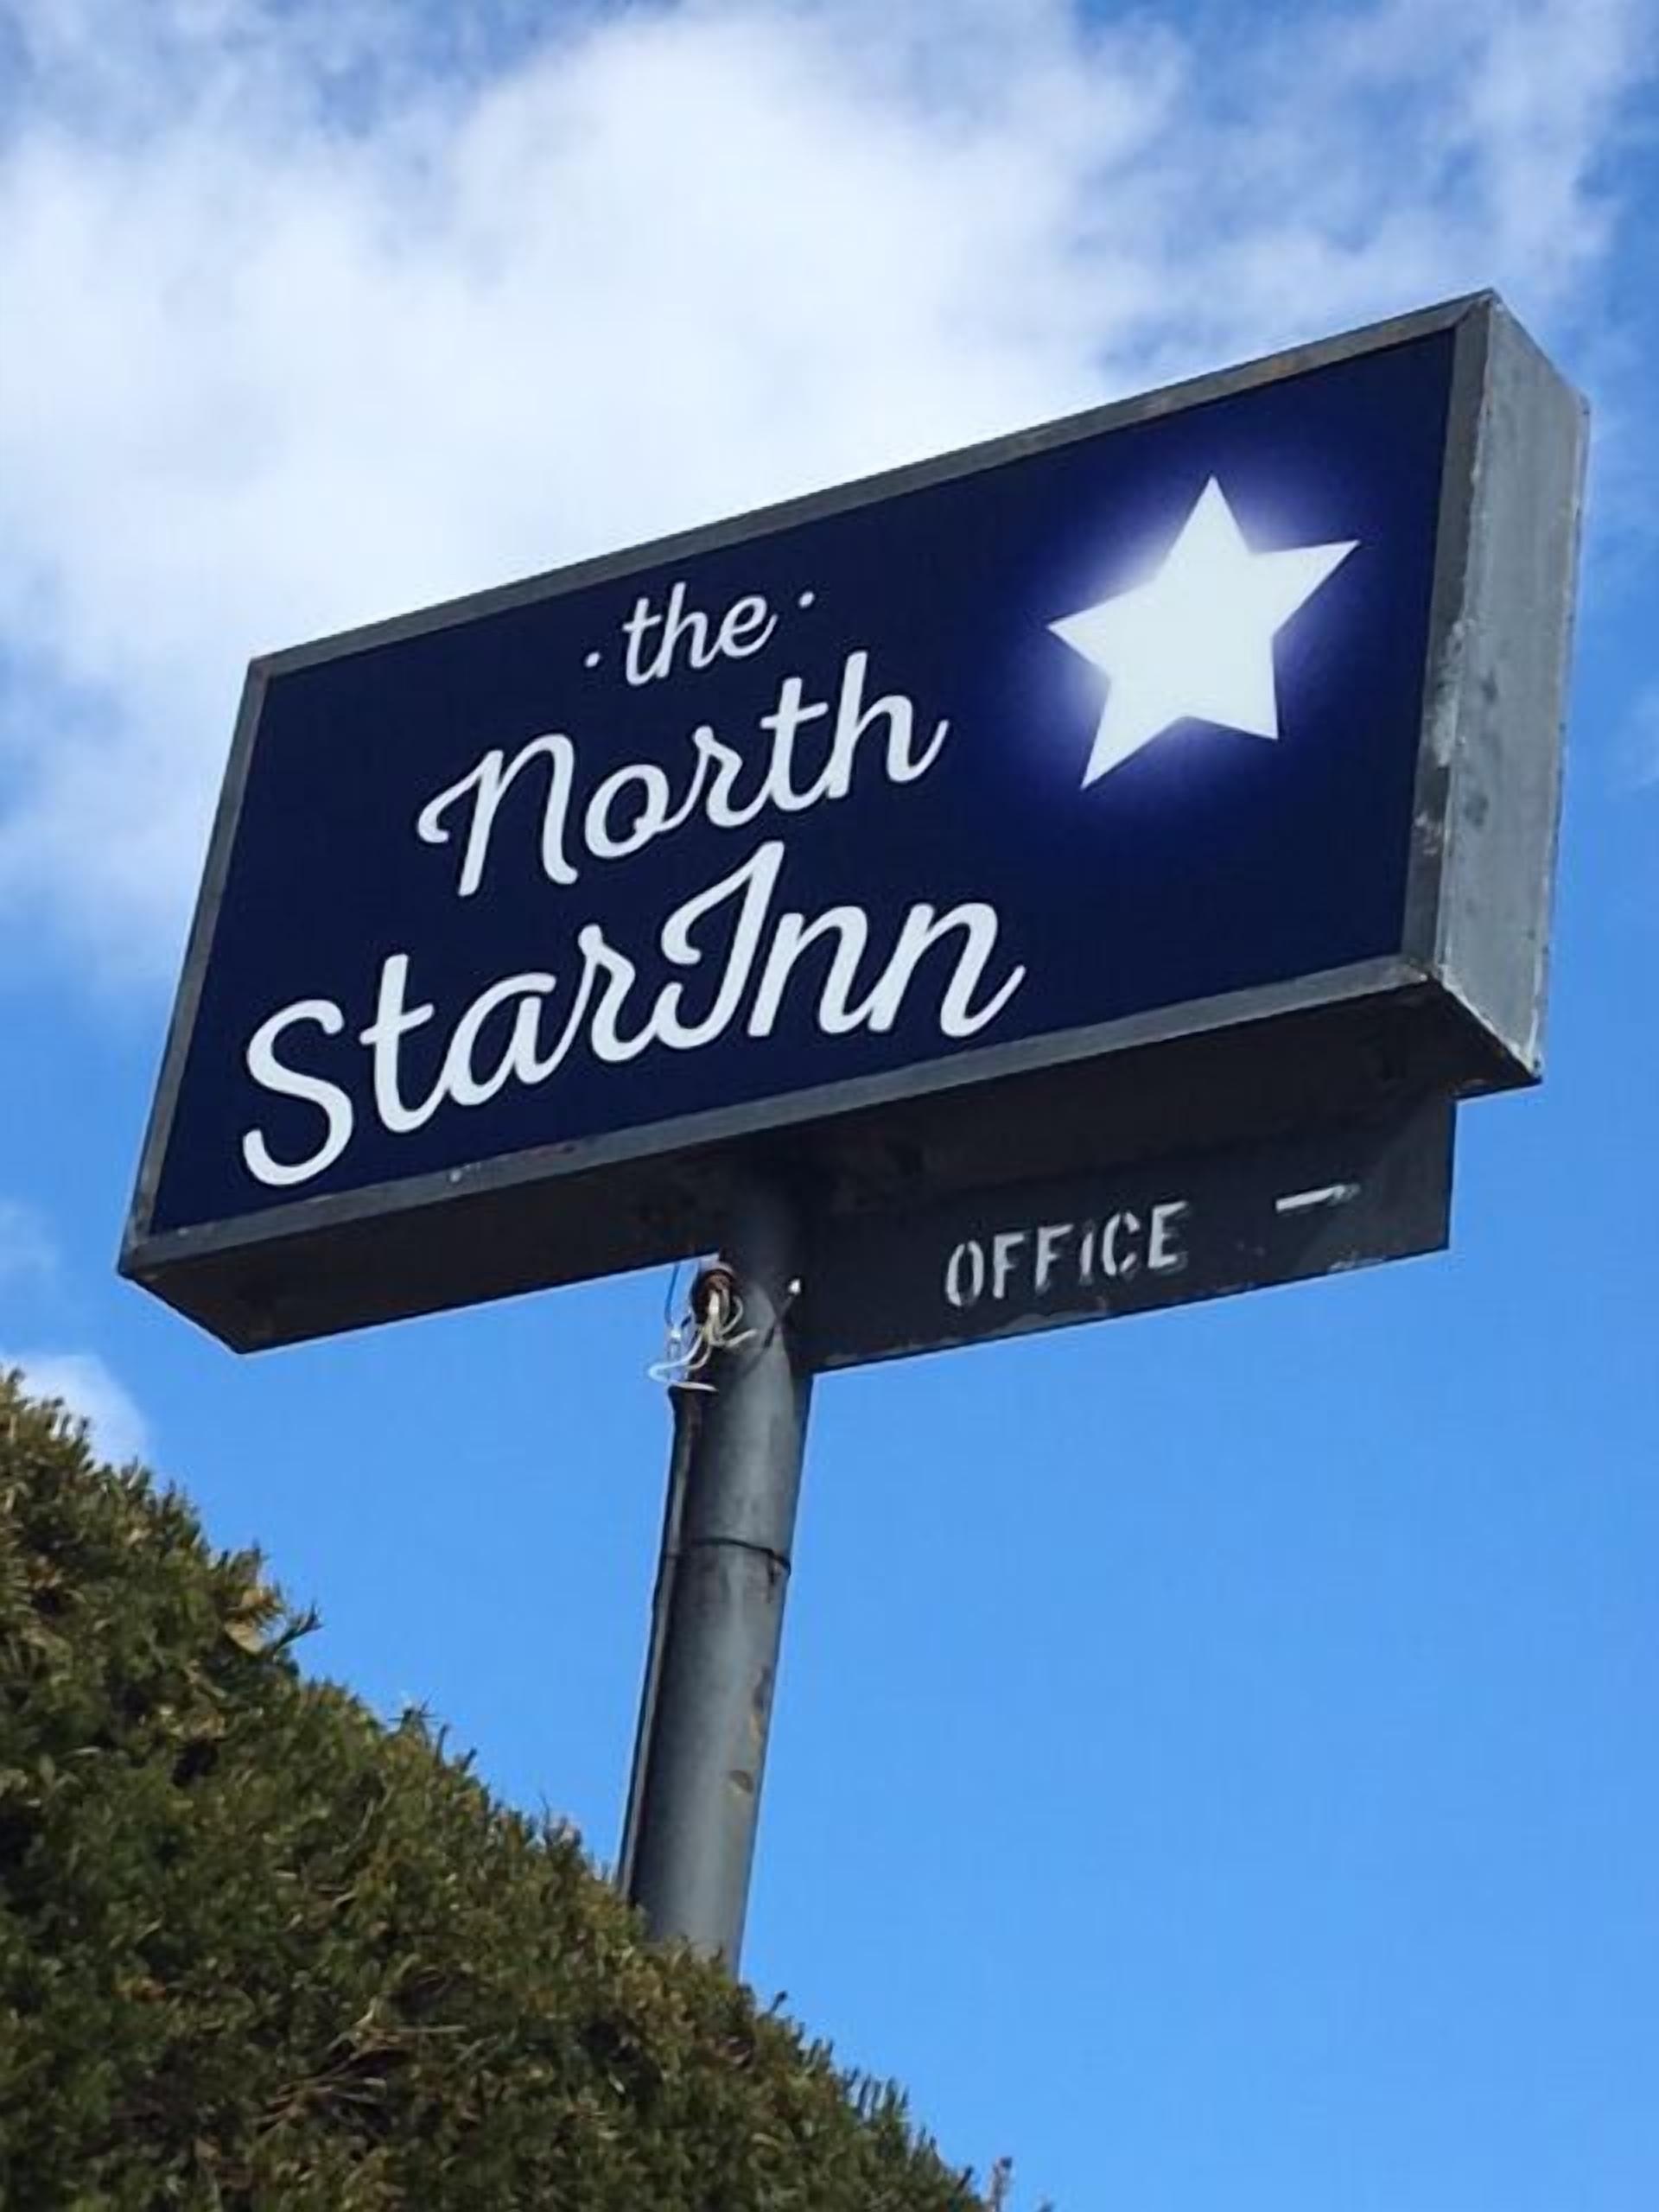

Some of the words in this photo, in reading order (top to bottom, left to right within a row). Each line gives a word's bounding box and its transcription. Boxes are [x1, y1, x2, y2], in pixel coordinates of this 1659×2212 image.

[622, 581, 778, 686] the
[416, 650, 949, 897] North
[945, 1200, 1188, 1306] OFFICE
